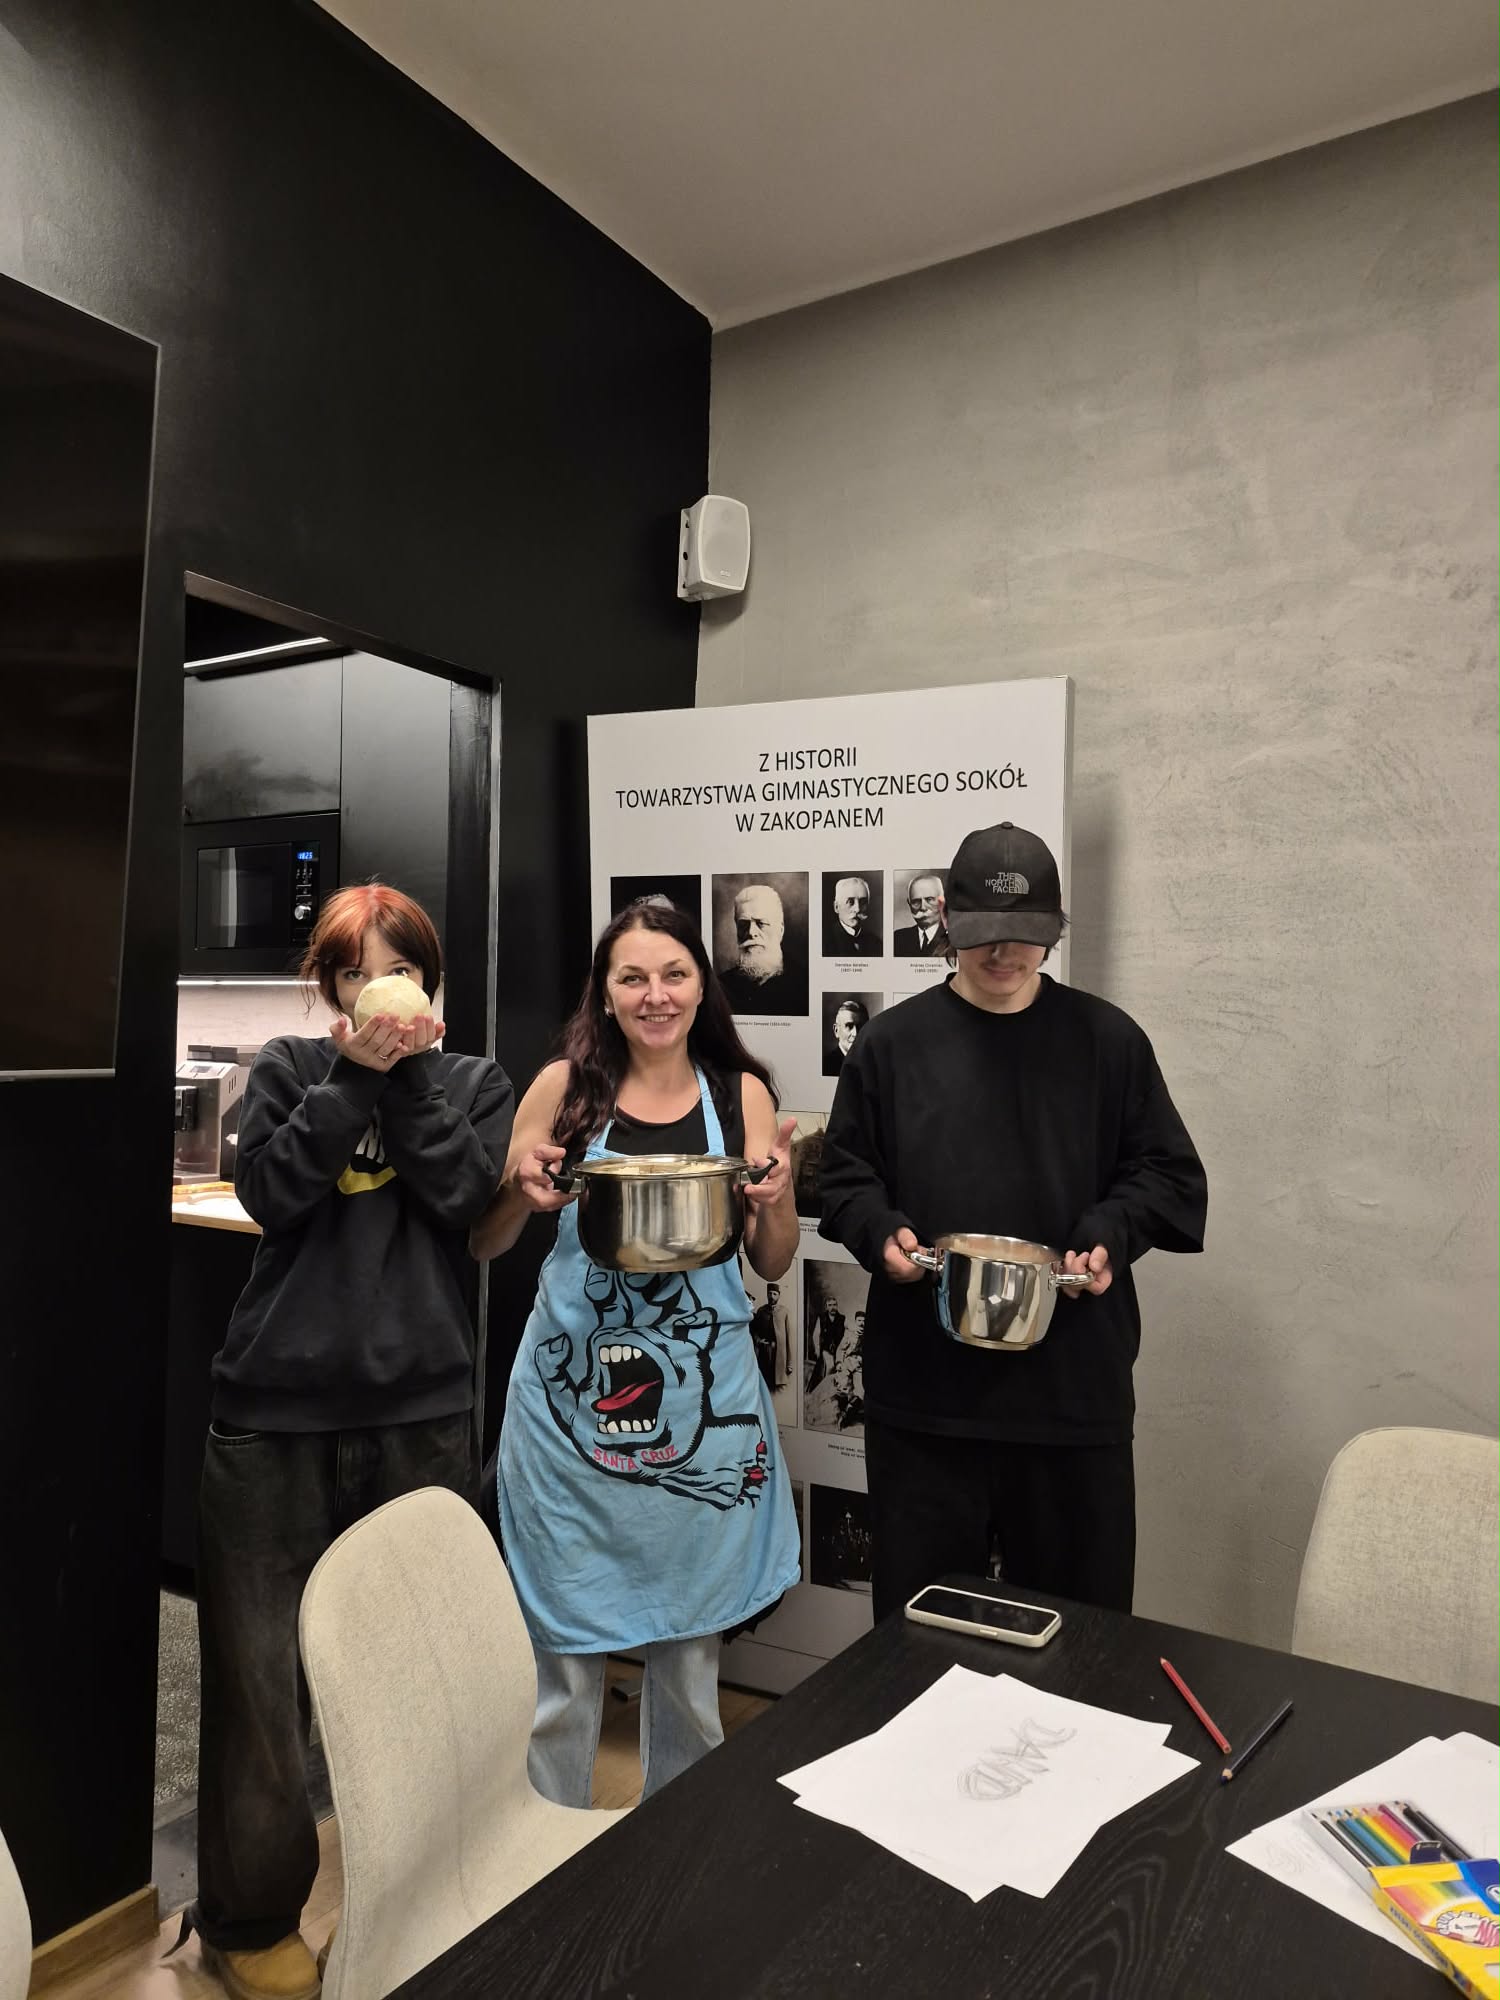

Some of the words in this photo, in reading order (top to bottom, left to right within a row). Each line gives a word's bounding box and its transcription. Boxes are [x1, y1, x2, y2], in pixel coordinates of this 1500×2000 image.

[759, 753, 770, 773] Z
[776, 747, 857, 770] HISTORII
[616, 784, 756, 809] TOWARZYSTWA
[762, 772, 949, 802] GIMNASTYCZNEGO
[956, 763, 1028, 792] SOKÓŁ
[736, 813, 755, 832] W
[761, 807, 883, 831] ZAKOPANEM
[985, 879, 1015, 888] NORTH
[997, 872, 1015, 880] THE
[992, 886, 1015, 894] FACE
[592, 1447, 639, 1472] SANTA
[640, 1444, 679, 1464] CRUZ
